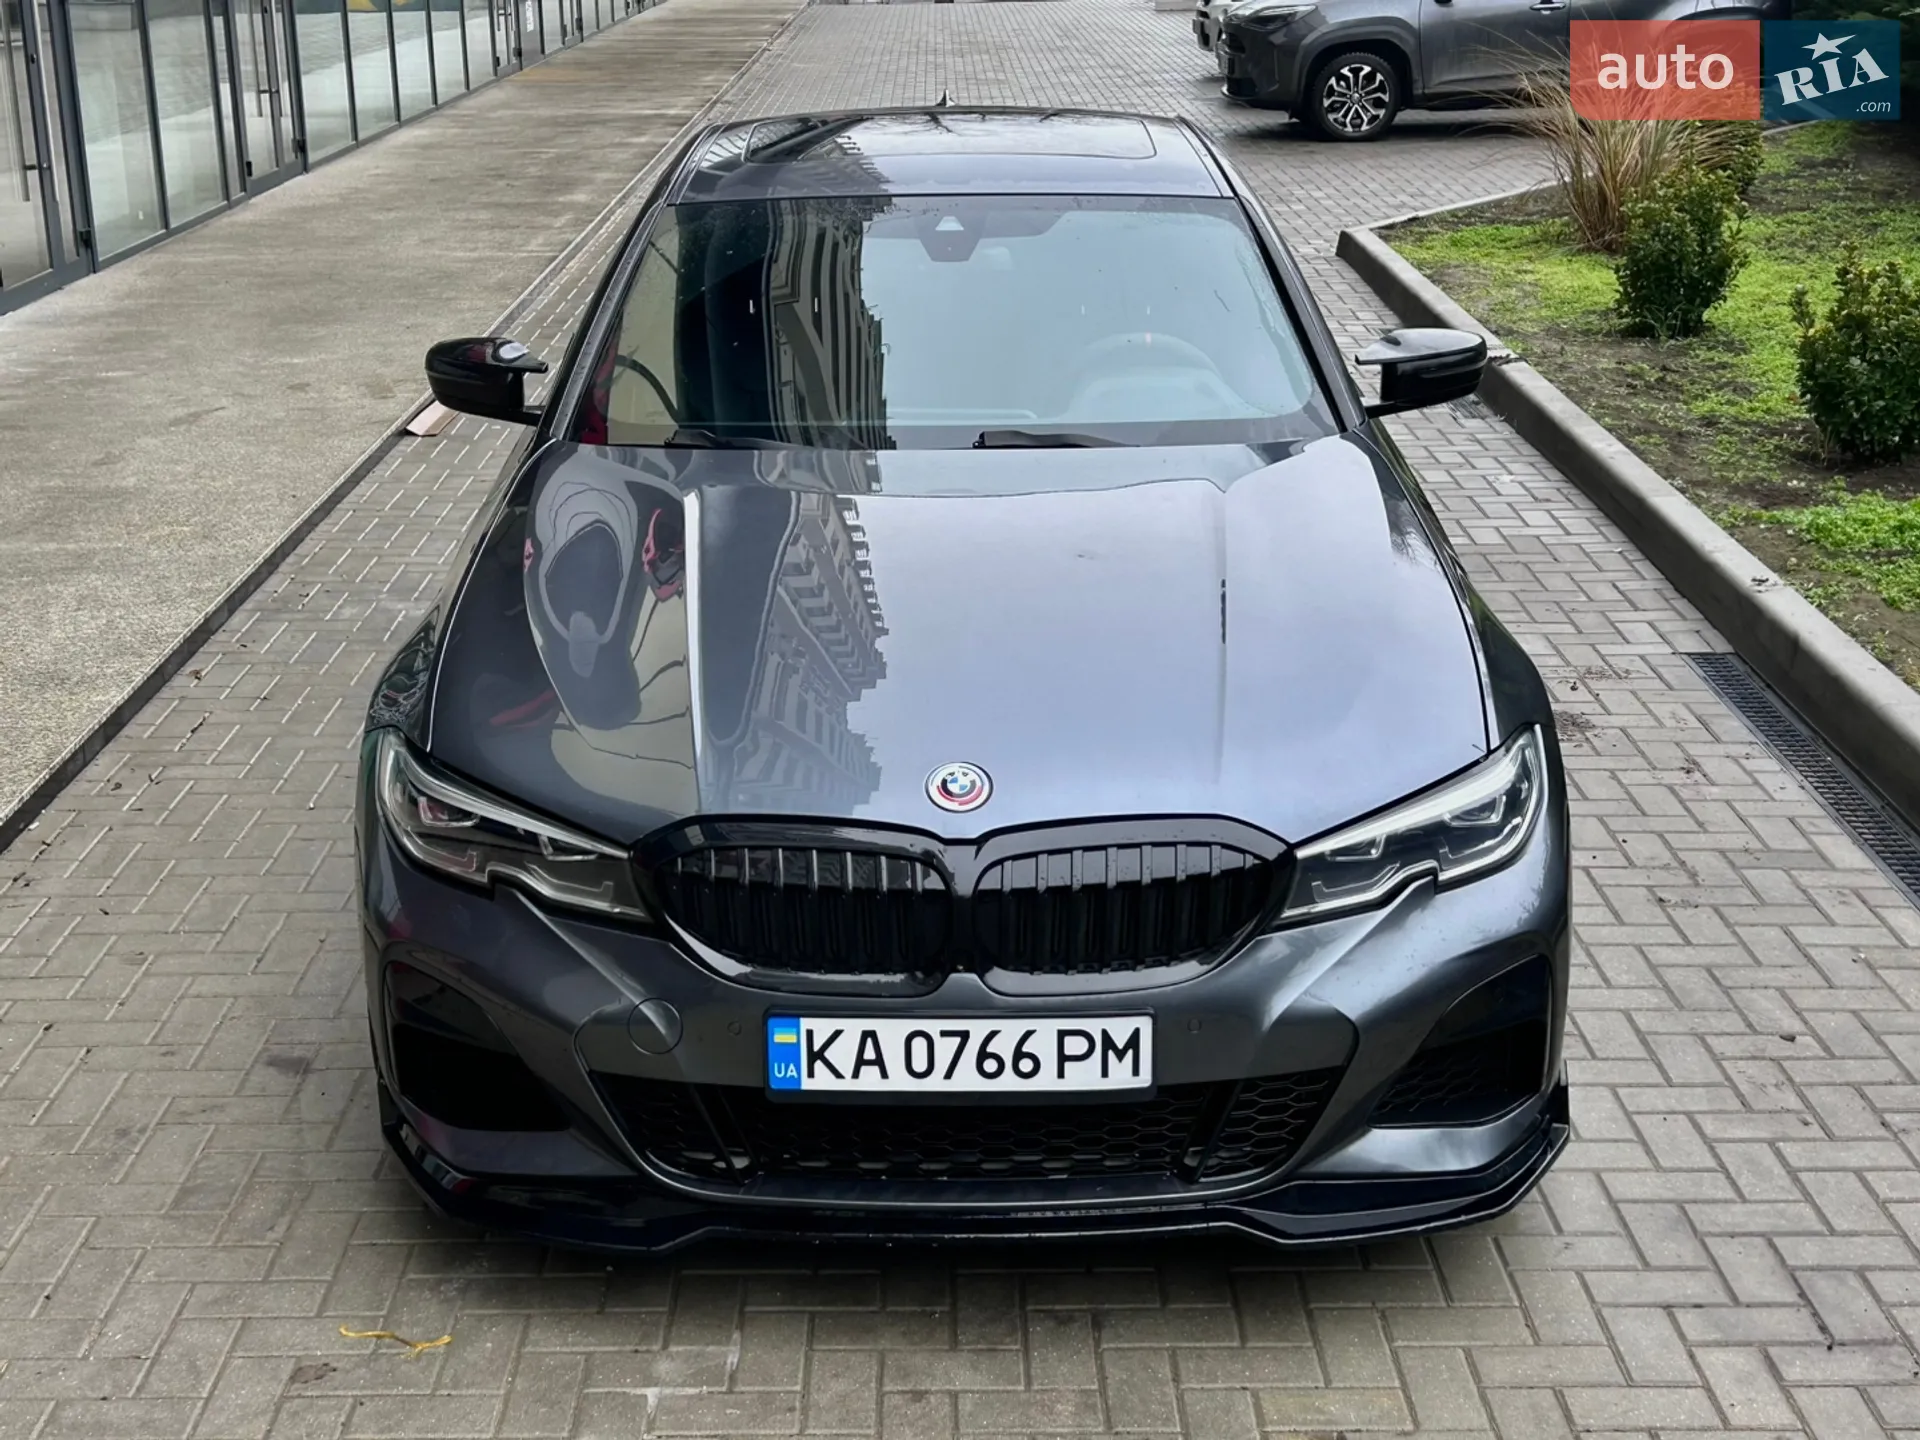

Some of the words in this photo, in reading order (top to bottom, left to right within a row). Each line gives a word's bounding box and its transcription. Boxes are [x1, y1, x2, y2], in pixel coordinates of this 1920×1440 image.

[773, 1062, 798, 1079] UA
[805, 1028, 889, 1080] KA
[904, 1029, 1041, 1080] 0766
[1056, 1026, 1141, 1080] PM
